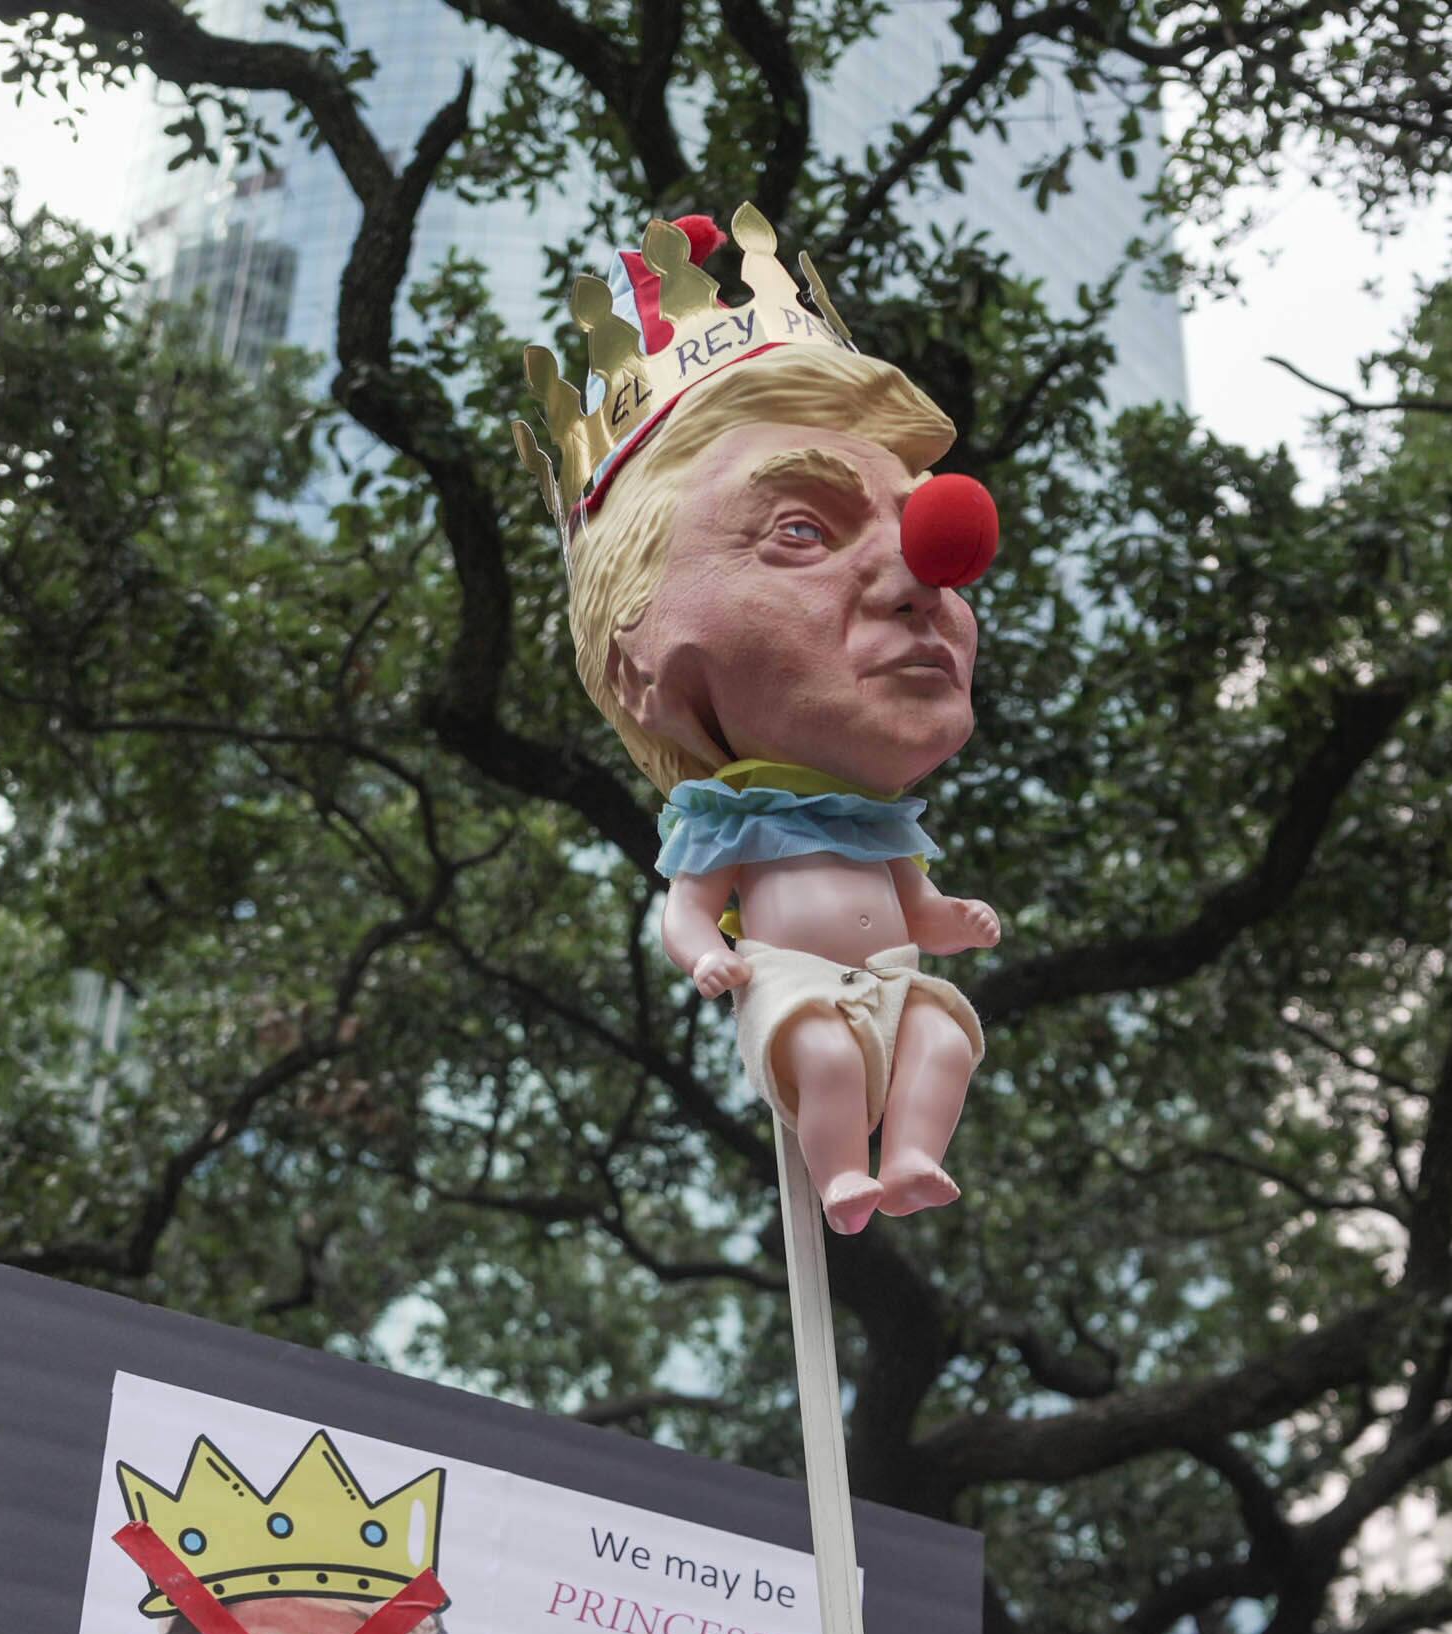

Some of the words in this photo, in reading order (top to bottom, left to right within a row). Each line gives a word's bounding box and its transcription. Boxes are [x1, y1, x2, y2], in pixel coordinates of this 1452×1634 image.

[612, 376, 653, 426] EL
[676, 308, 755, 377] REY
[591, 1527, 651, 1570] We
[664, 1557, 741, 1602] may
[754, 1568, 796, 1609] be
